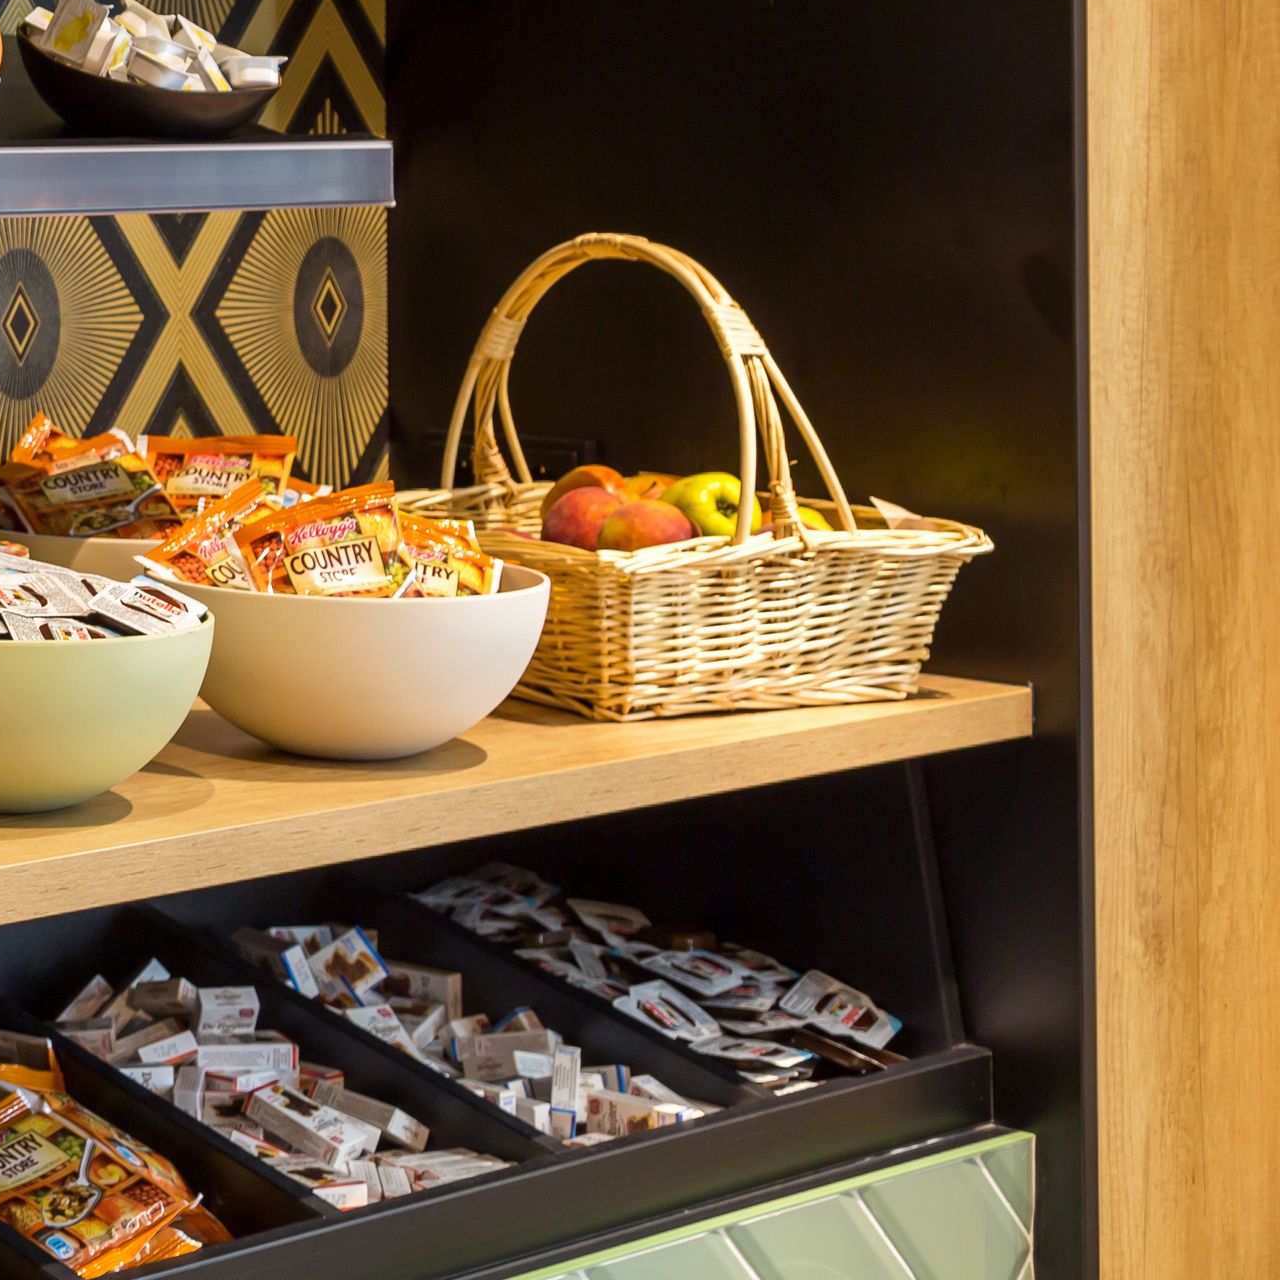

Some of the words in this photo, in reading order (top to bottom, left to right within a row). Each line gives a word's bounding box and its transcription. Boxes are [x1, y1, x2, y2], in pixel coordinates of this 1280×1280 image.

[43, 467, 121, 490] COUNTRY
[290, 517, 357, 545] Kellogg's
[290, 541, 374, 575] COUNTRY
[1, 1156, 39, 1179] STORE
